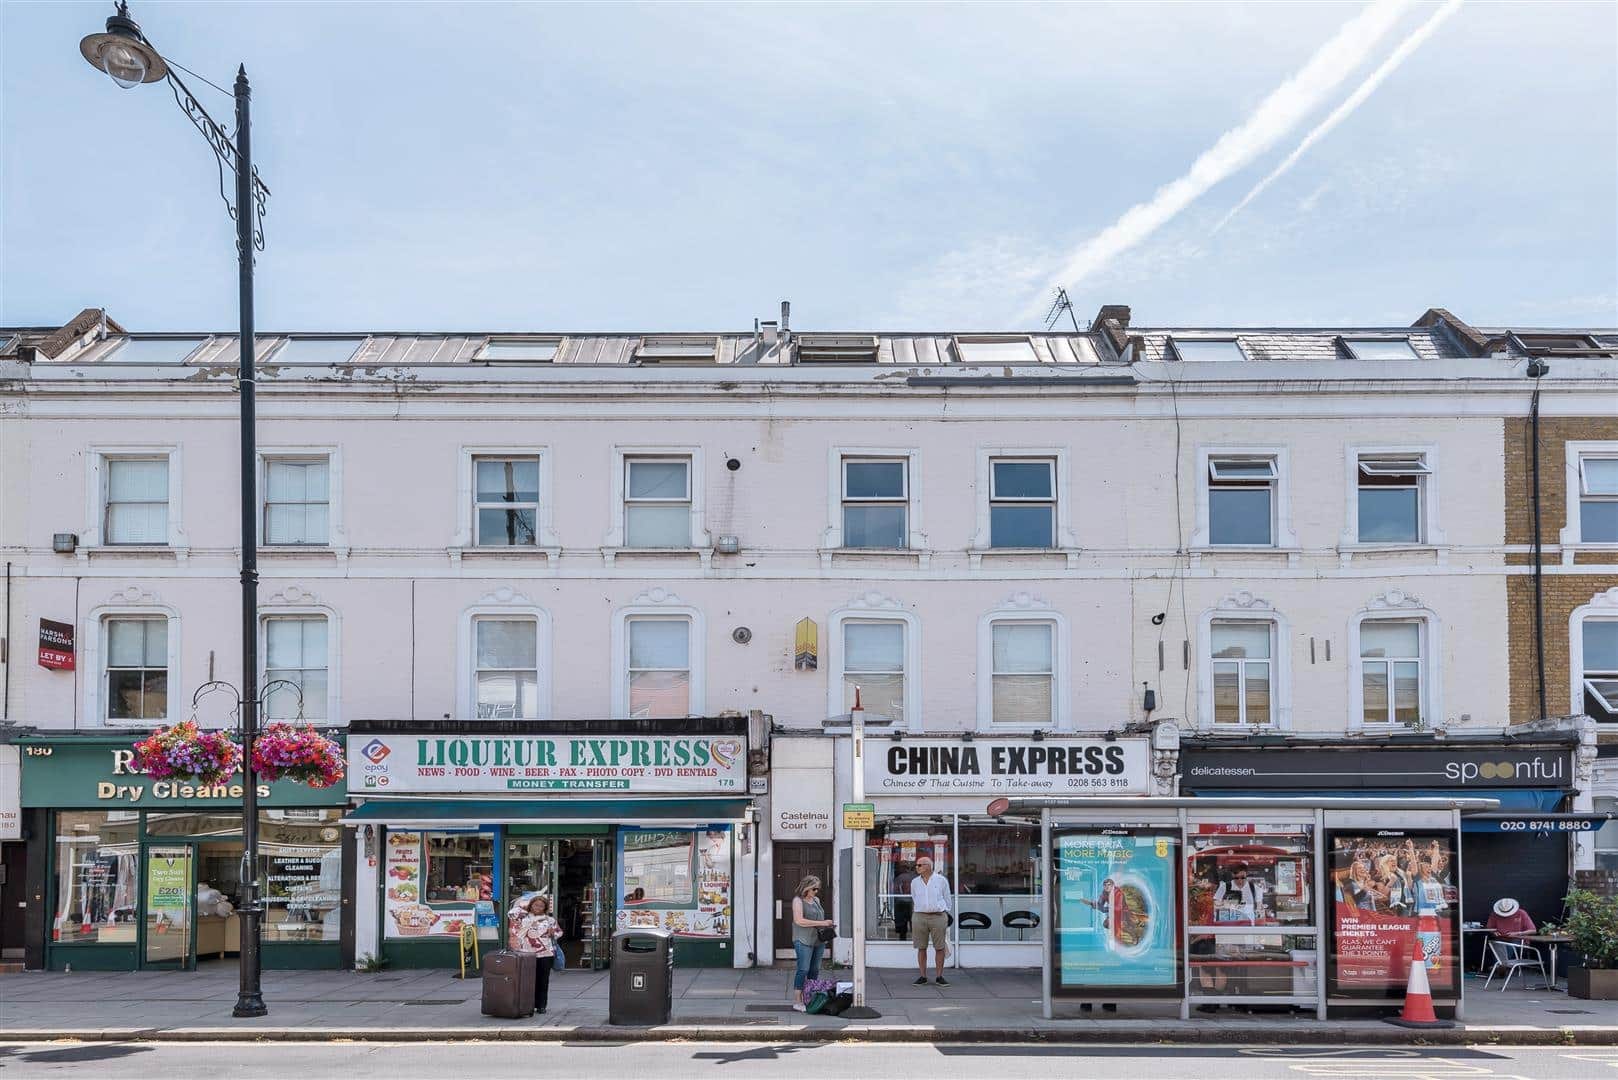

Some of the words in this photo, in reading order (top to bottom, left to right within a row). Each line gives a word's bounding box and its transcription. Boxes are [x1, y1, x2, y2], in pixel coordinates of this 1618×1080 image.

[40, 634, 73, 645] PARSONS
[40, 651, 55, 660] LET
[55, 654, 67, 662] BY
[417, 739, 557, 767] LIQUEUR
[569, 739, 710, 767] EXPRESS
[887, 746, 980, 775] CHINA
[991, 746, 1125, 775] EXPRESS
[365, 764, 388, 773] epay
[418, 768, 445, 777] NEWS
[454, 768, 480, 777] FOOD
[490, 768, 515, 777] WINE
[525, 768, 550, 777] BEER
[559, 768, 577, 777] FAX
[586, 768, 618, 777] PHOTO
[621, 768, 645, 777] COPY
[654, 768, 673, 777] DVD
[676, 768, 718, 777] RENTALS
[1190, 766, 1256, 776] delicatessen
[1445, 757, 1563, 784] spoonful
[512, 780, 556, 788] MONEY
[562, 780, 625, 788] TRANSFER
[717, 779, 734, 787] 178
[883, 778, 916, 788] Chinese
[917, 778, 927, 787] &
[953, 778, 985, 788] Cuisine
[991, 778, 1002, 787] To
[1006, 778, 1053, 789] Take-away
[1067, 778, 1089, 787] 0208
[1091, 778, 1107, 787] 563
[1110, 778, 1129, 787] 8118
[97, 782, 144, 804] Dry
[152, 781, 271, 800] Cleanes
[781, 812, 829, 820] Castelnau
[781, 821, 808, 830] Court
[1500, 821, 1526, 831] 020
[1529, 821, 1555, 831] 8741
[1558, 821, 1592, 831] 8880
[1064, 840, 1095, 849] MORE
[1097, 840, 1124, 849] DATA
[1064, 849, 1095, 858] MORE
[1097, 849, 1133, 858] MAGIC
